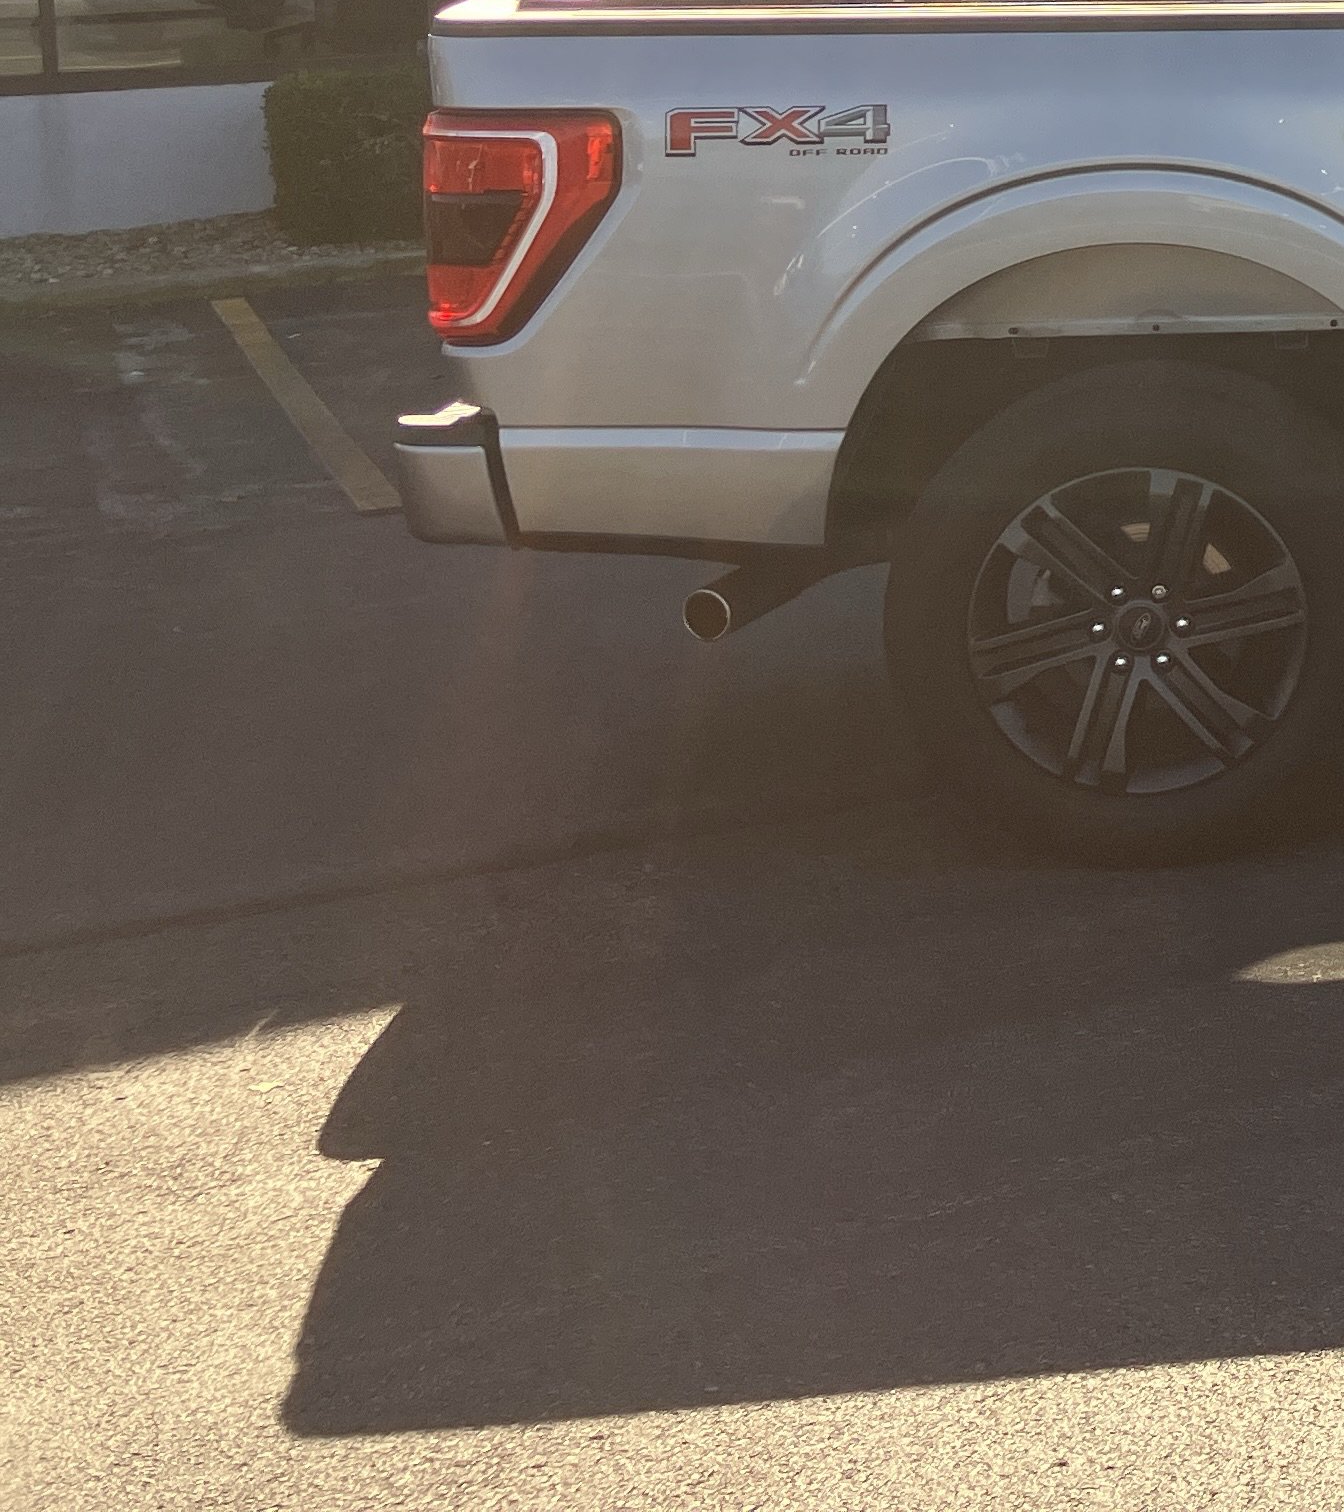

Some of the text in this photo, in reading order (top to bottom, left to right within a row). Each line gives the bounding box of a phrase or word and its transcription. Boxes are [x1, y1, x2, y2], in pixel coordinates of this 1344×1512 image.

[664, 103, 891, 157] FX4
[788, 147, 889, 157] OFF ROAD
